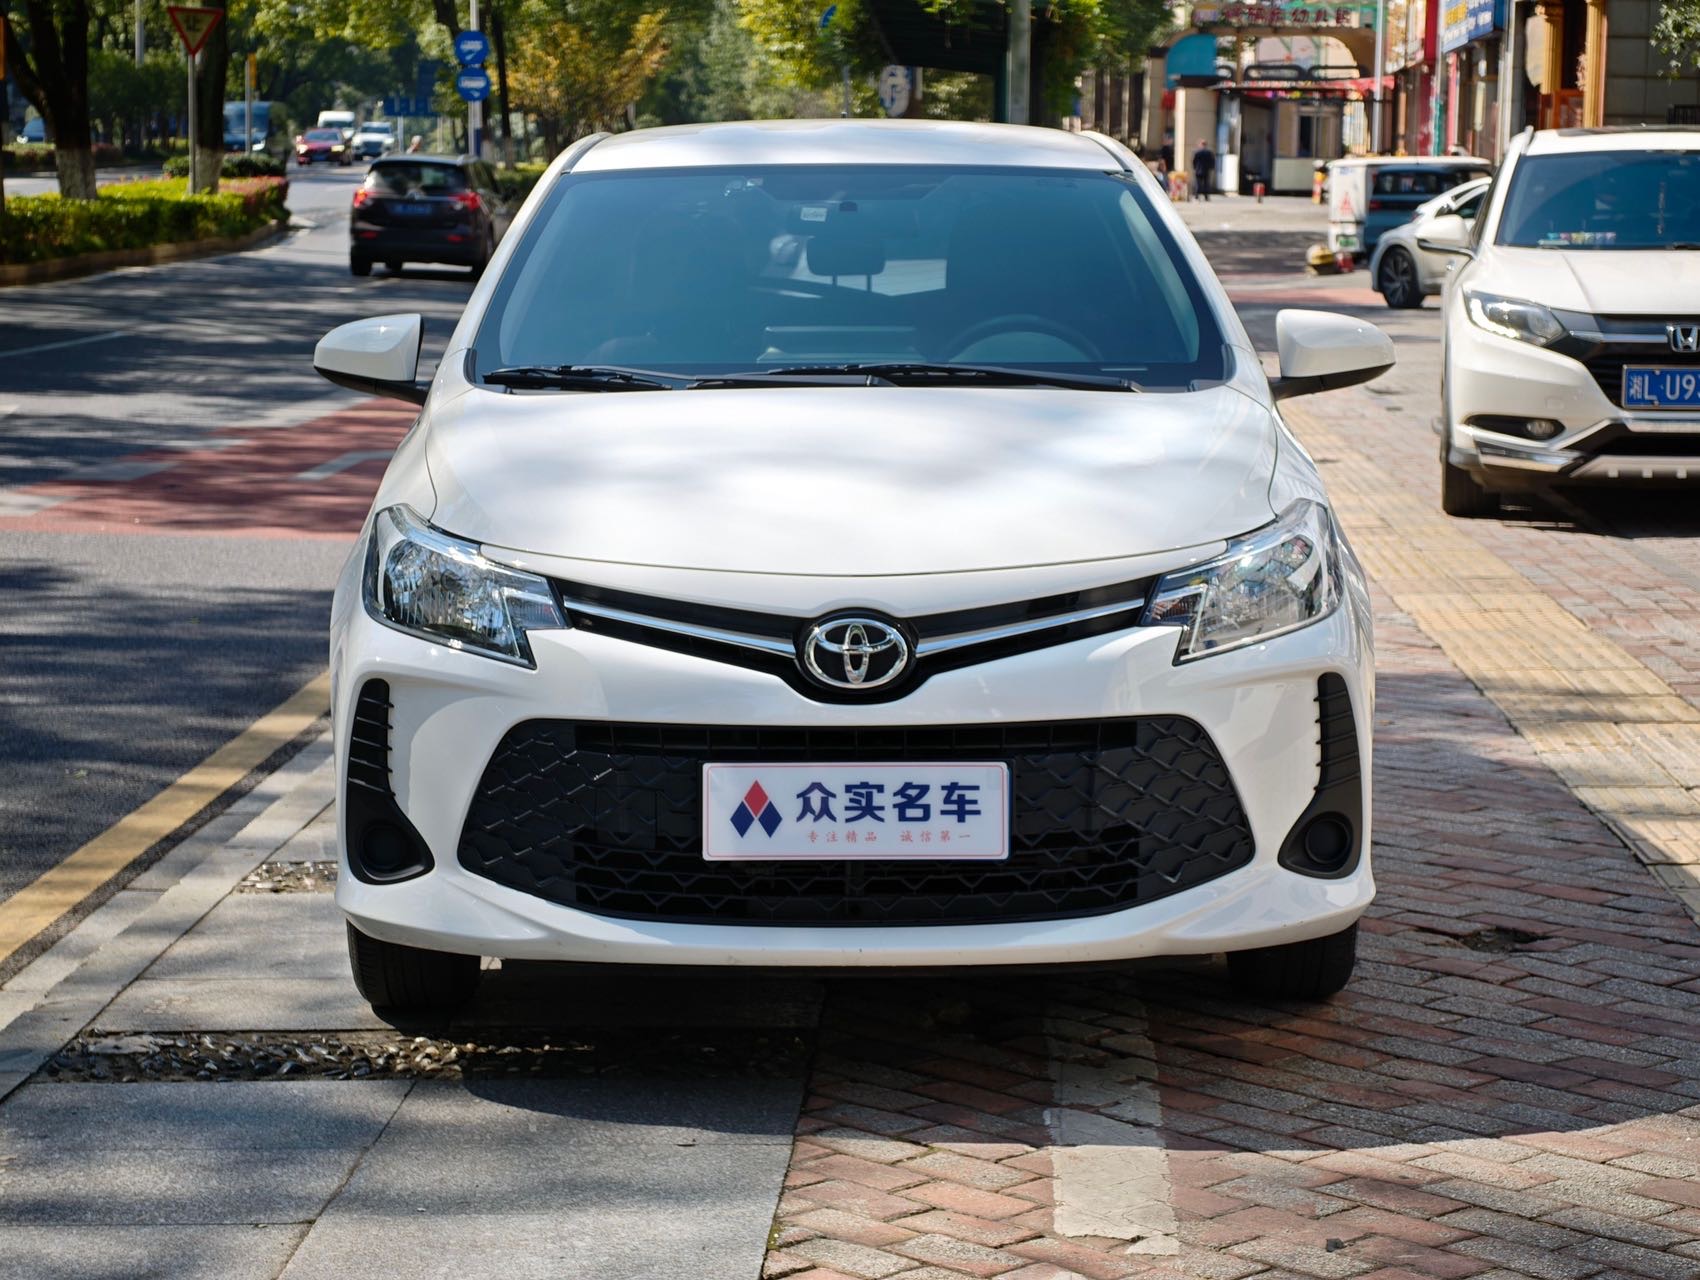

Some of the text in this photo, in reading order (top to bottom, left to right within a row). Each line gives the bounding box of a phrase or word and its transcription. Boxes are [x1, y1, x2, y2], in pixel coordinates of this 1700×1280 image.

[1629, 374, 1700, 401] 湘L·U9
[796, 782, 982, 823] 众实名车
[808, 830, 877, 843] 专注精品
